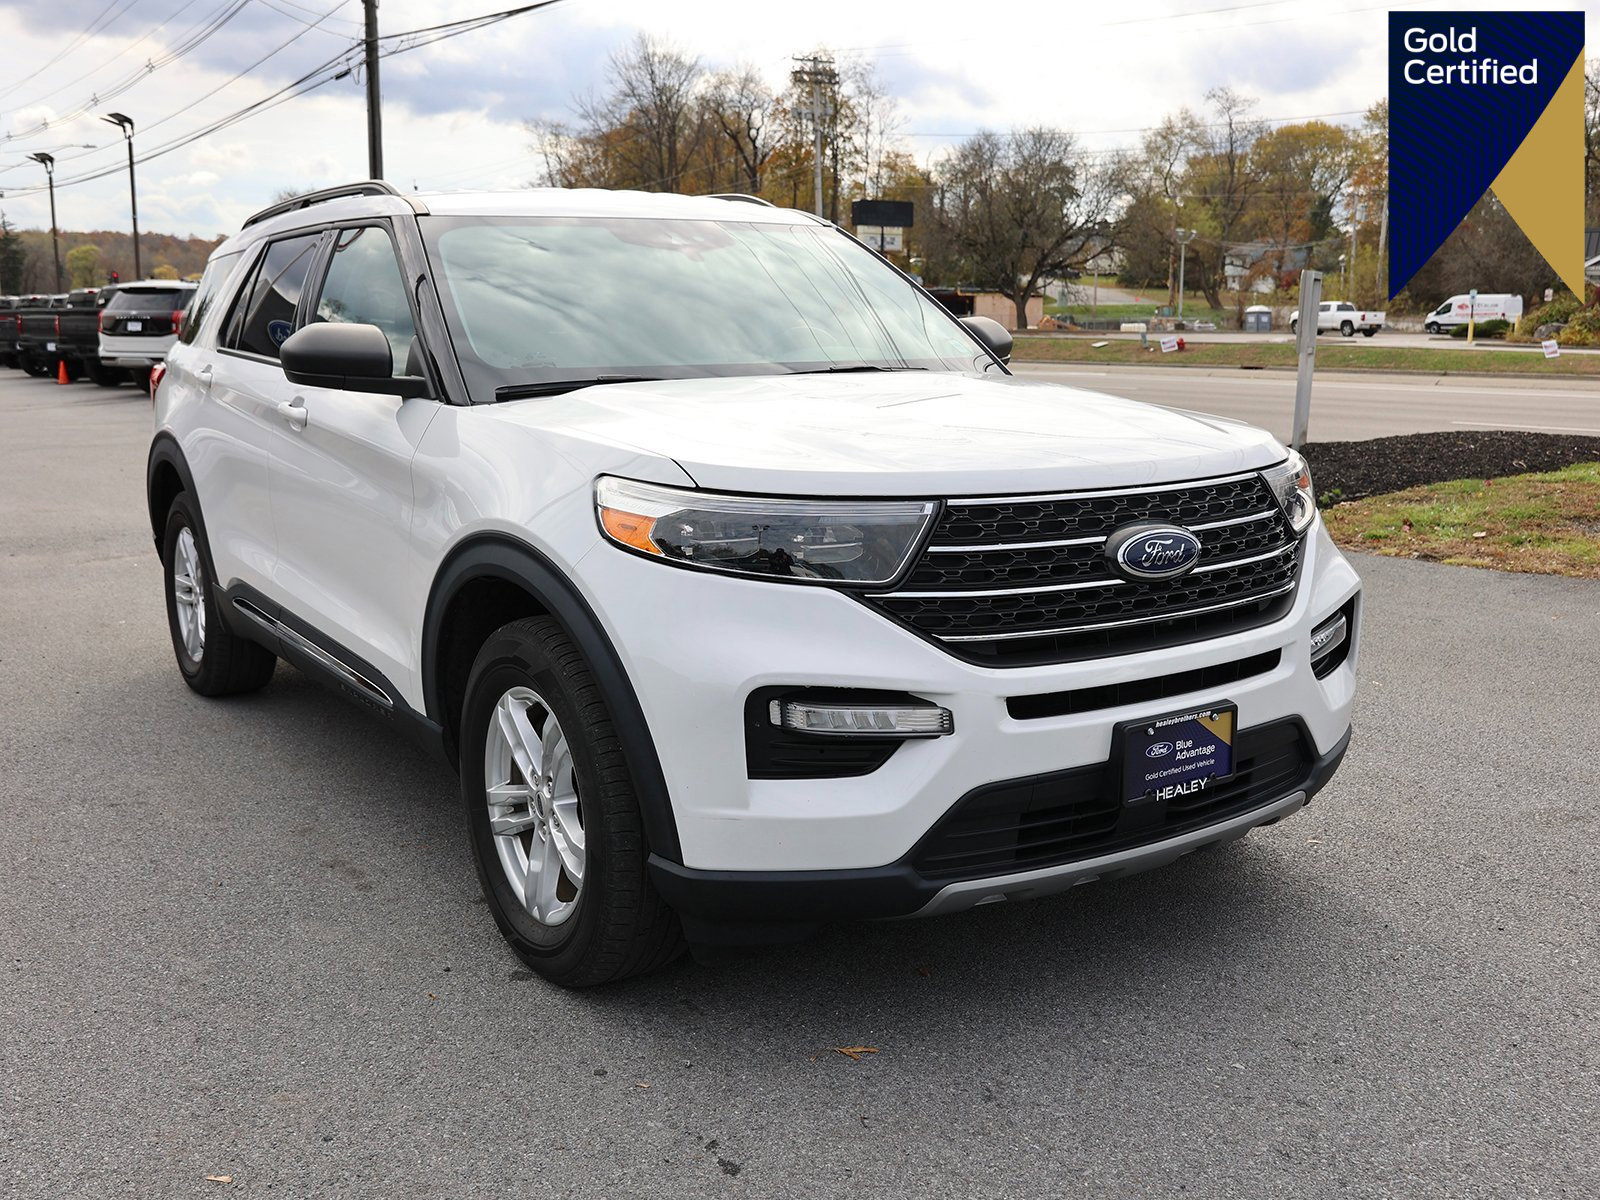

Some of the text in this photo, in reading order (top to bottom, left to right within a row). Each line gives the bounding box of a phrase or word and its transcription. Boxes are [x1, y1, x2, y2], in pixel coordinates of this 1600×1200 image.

[1142, 539, 1186, 567] Ford
[1155, 710, 1212, 728] healeybrothers.com
[1150, 744, 1169, 756] Ford
[1175, 739, 1193, 750] Blue
[1175, 744, 1216, 761] Advantage
[1145, 758, 1215, 781] Gold Certified Used Vehicle
[1156, 777, 1208, 802] HEALEY
